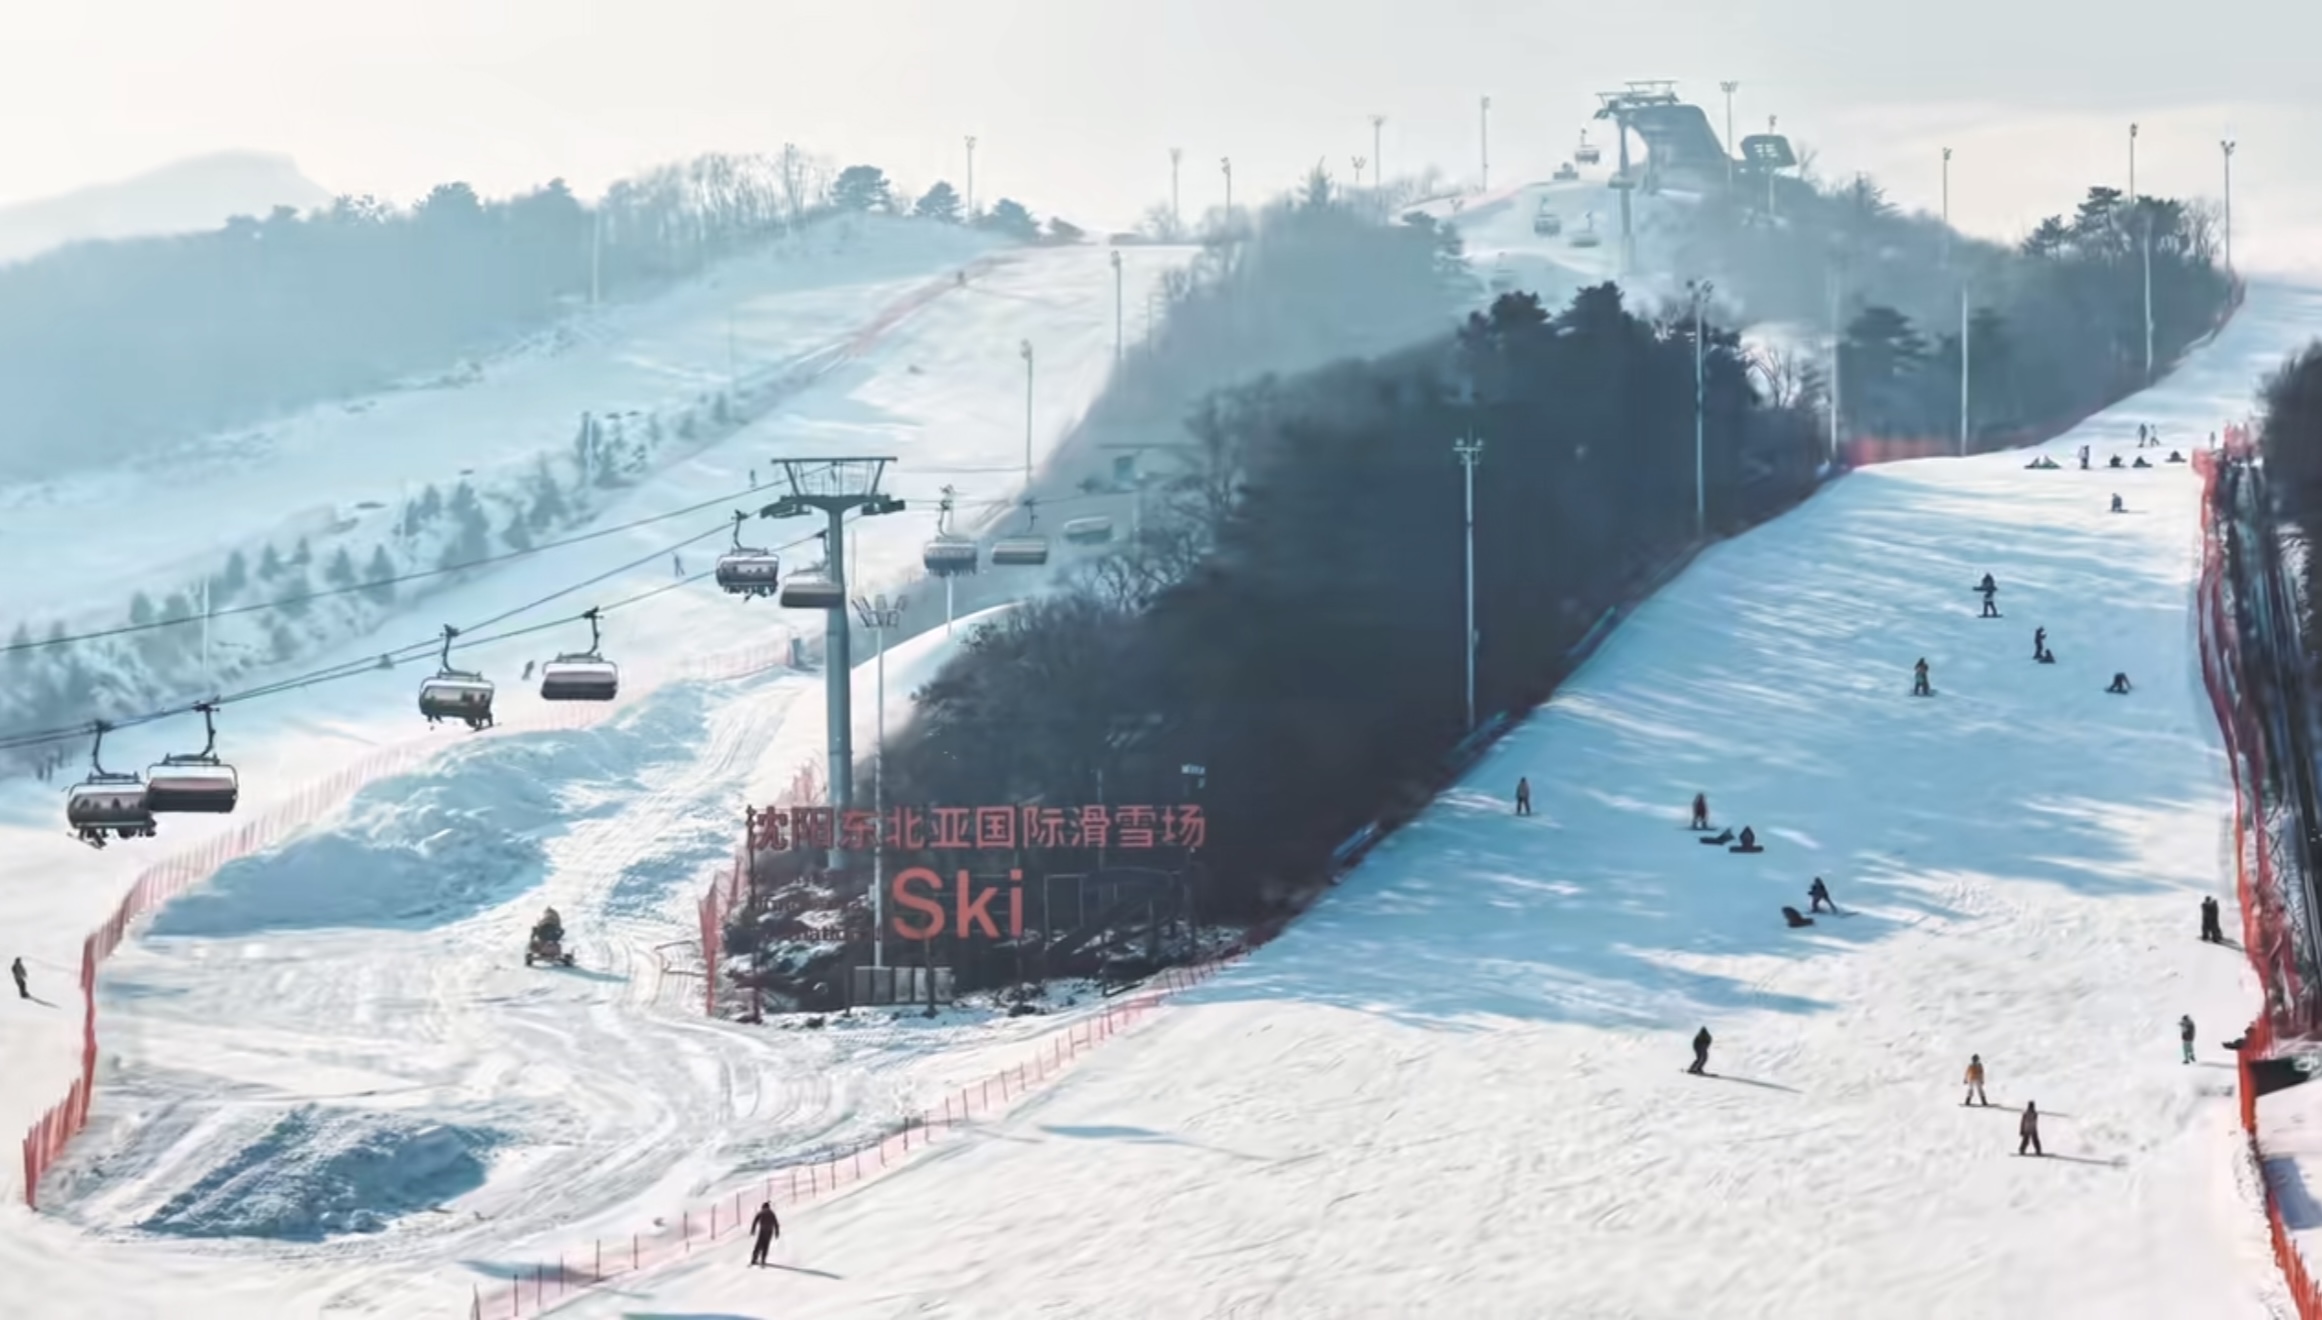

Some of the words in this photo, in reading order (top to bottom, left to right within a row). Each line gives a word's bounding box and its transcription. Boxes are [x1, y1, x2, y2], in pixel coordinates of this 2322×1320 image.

[746, 804, 1206, 851] 沈阳东北亚国际滑雪场
[892, 867, 1023, 940] Ski
